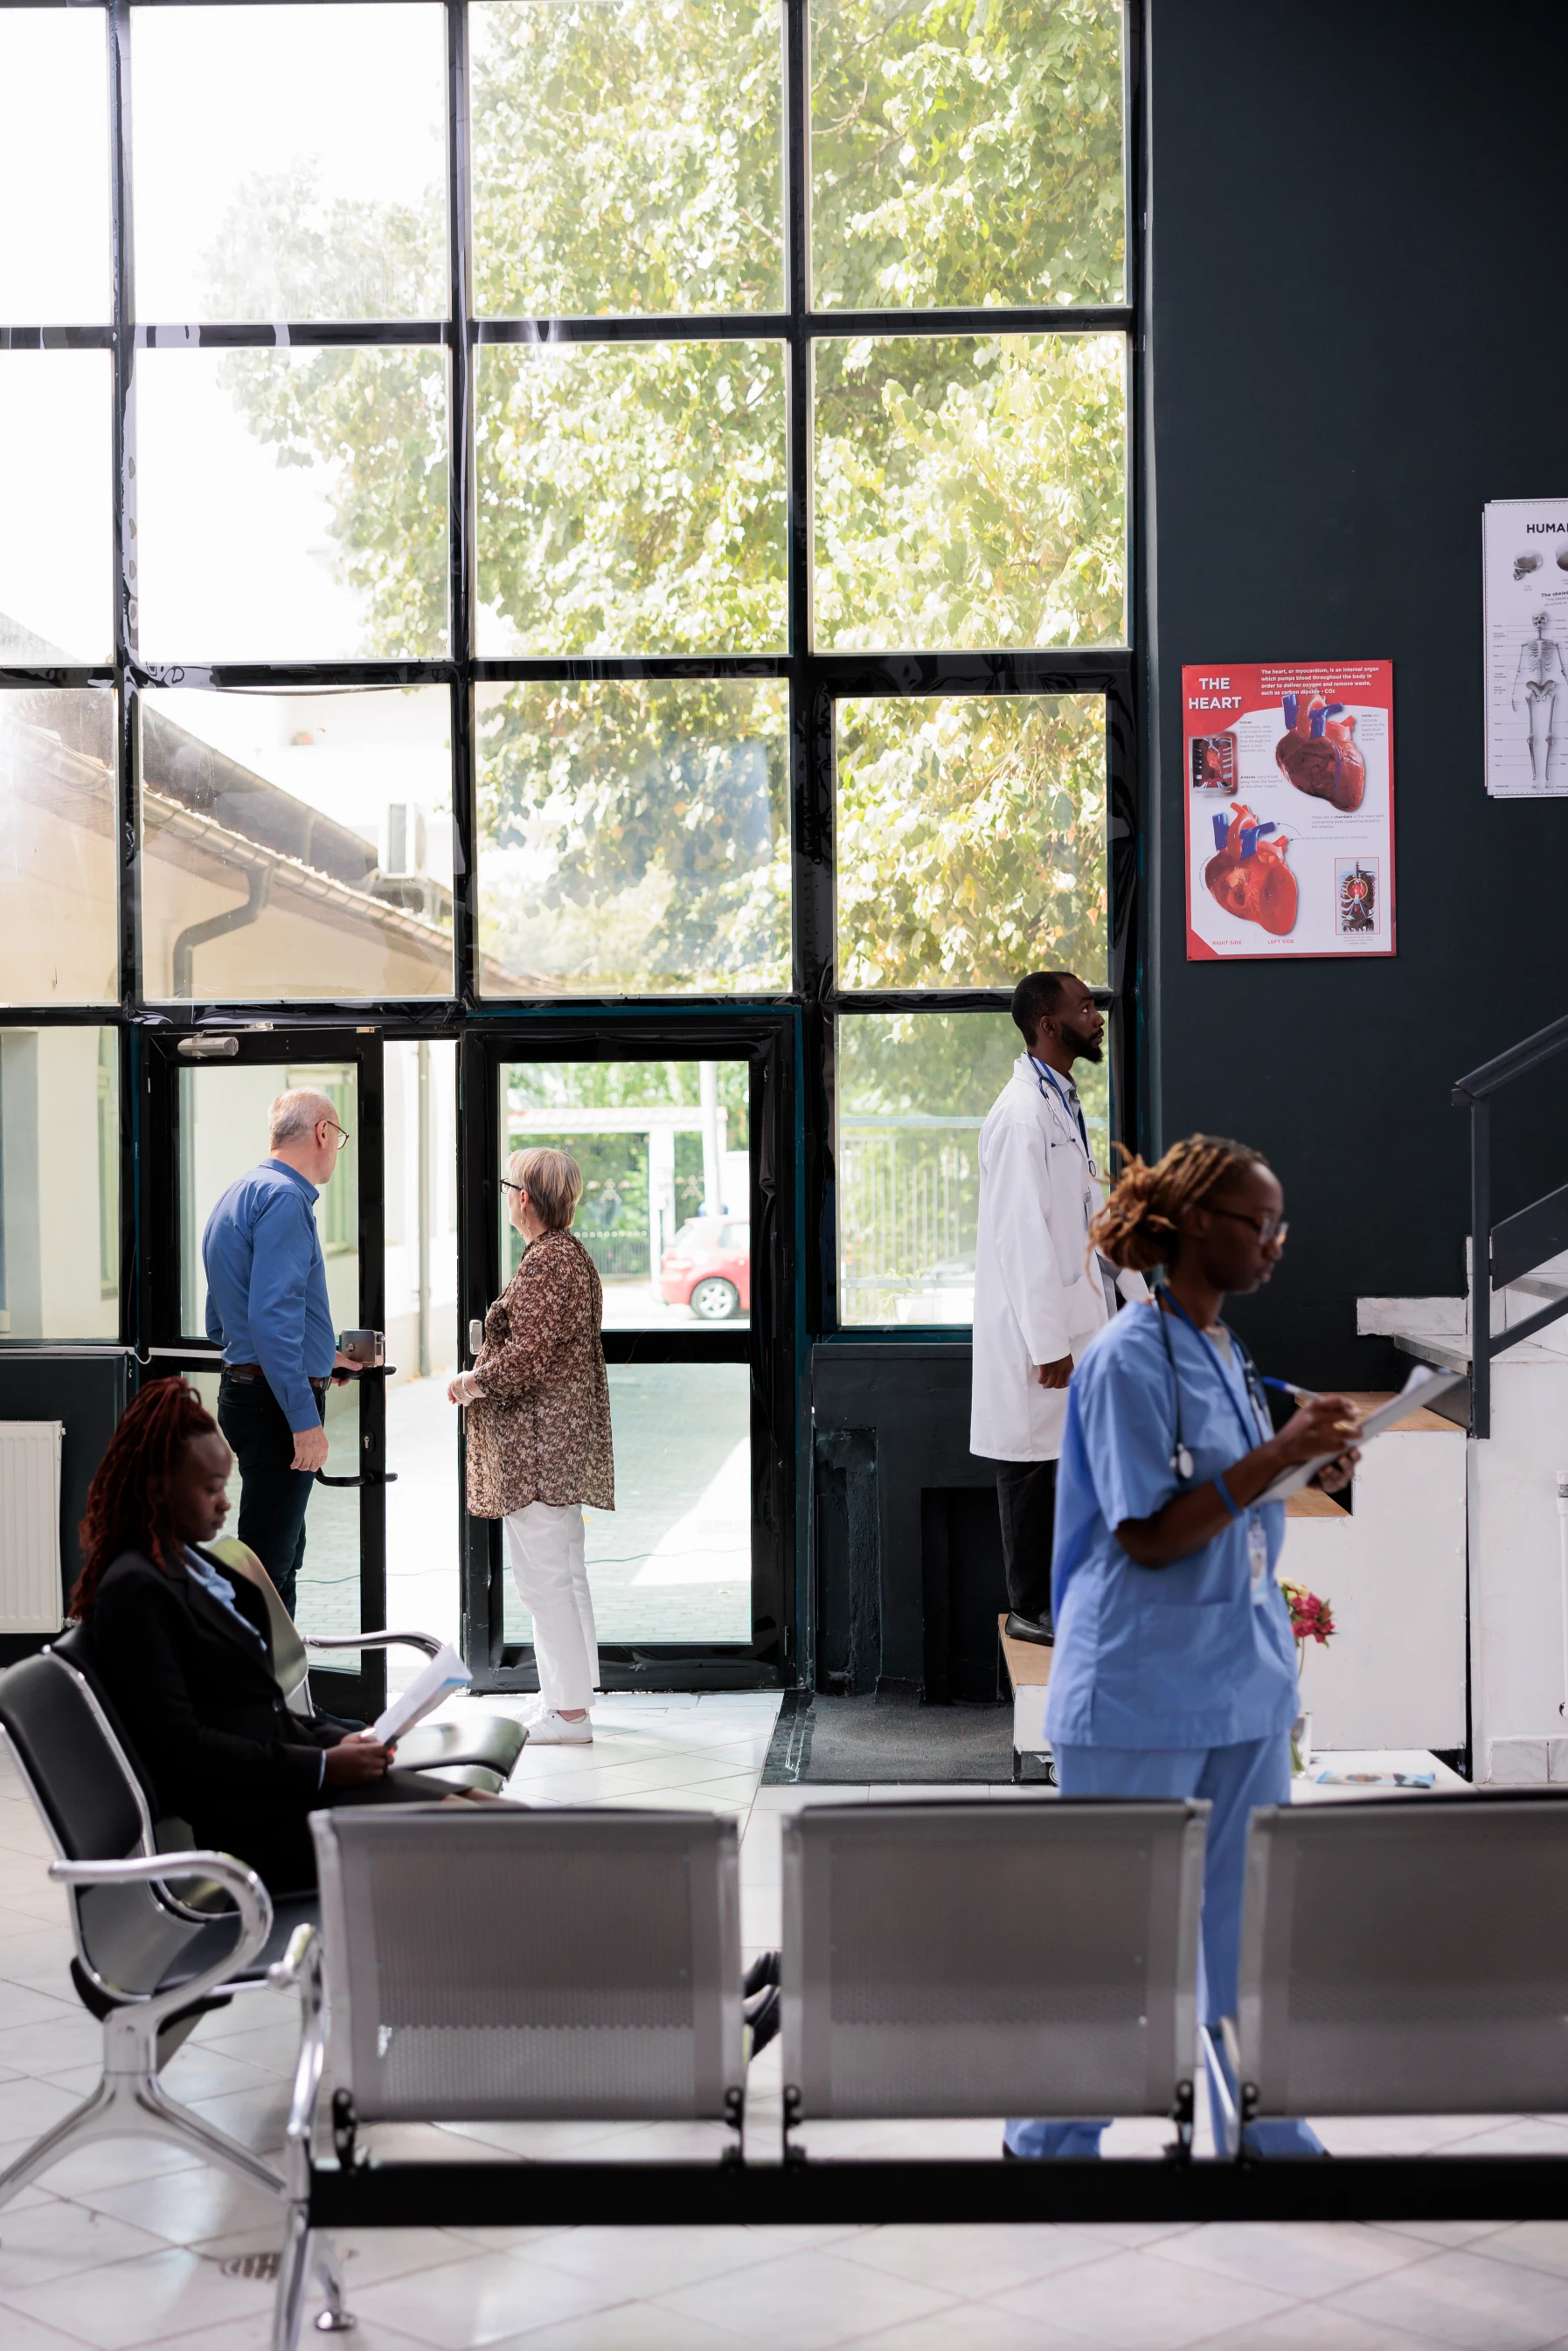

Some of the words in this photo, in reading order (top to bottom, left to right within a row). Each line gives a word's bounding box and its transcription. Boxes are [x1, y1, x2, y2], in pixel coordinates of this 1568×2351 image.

[1527, 524, 1568, 533] HUMA
[1199, 678, 1230, 690] THE
[1189, 697, 1242, 709] HEART
